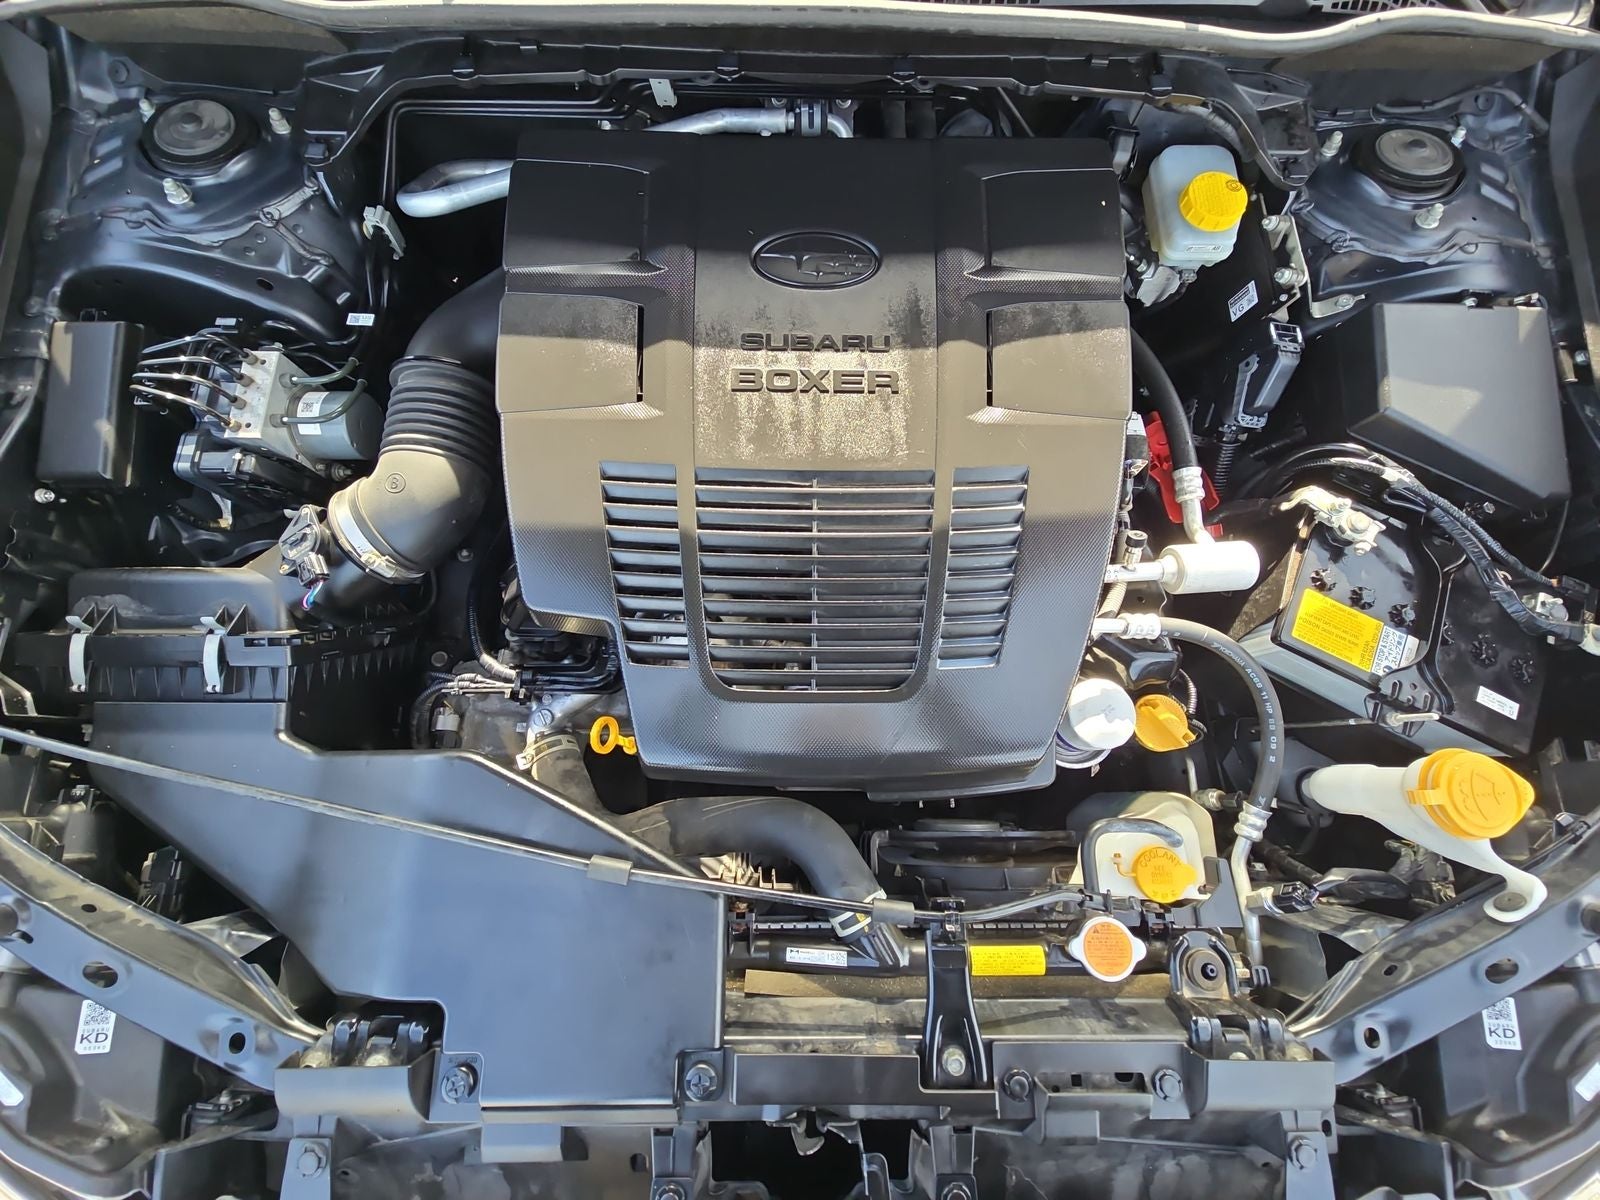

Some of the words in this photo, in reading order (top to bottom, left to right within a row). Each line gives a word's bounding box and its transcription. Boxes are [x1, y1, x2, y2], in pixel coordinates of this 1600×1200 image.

[1231, 304, 1245, 317] VG
[740, 332, 891, 353] SUBARU
[730, 367, 900, 395] BOXER
[1377, 648, 1386, 662] STOP
[1260, 691, 1269, 700] 11
[1264, 702, 1273, 714] HP
[1140, 849, 1182, 868] COOLANT
[80, 1032, 109, 1044] KD
[1488, 1027, 1516, 1039] KD
